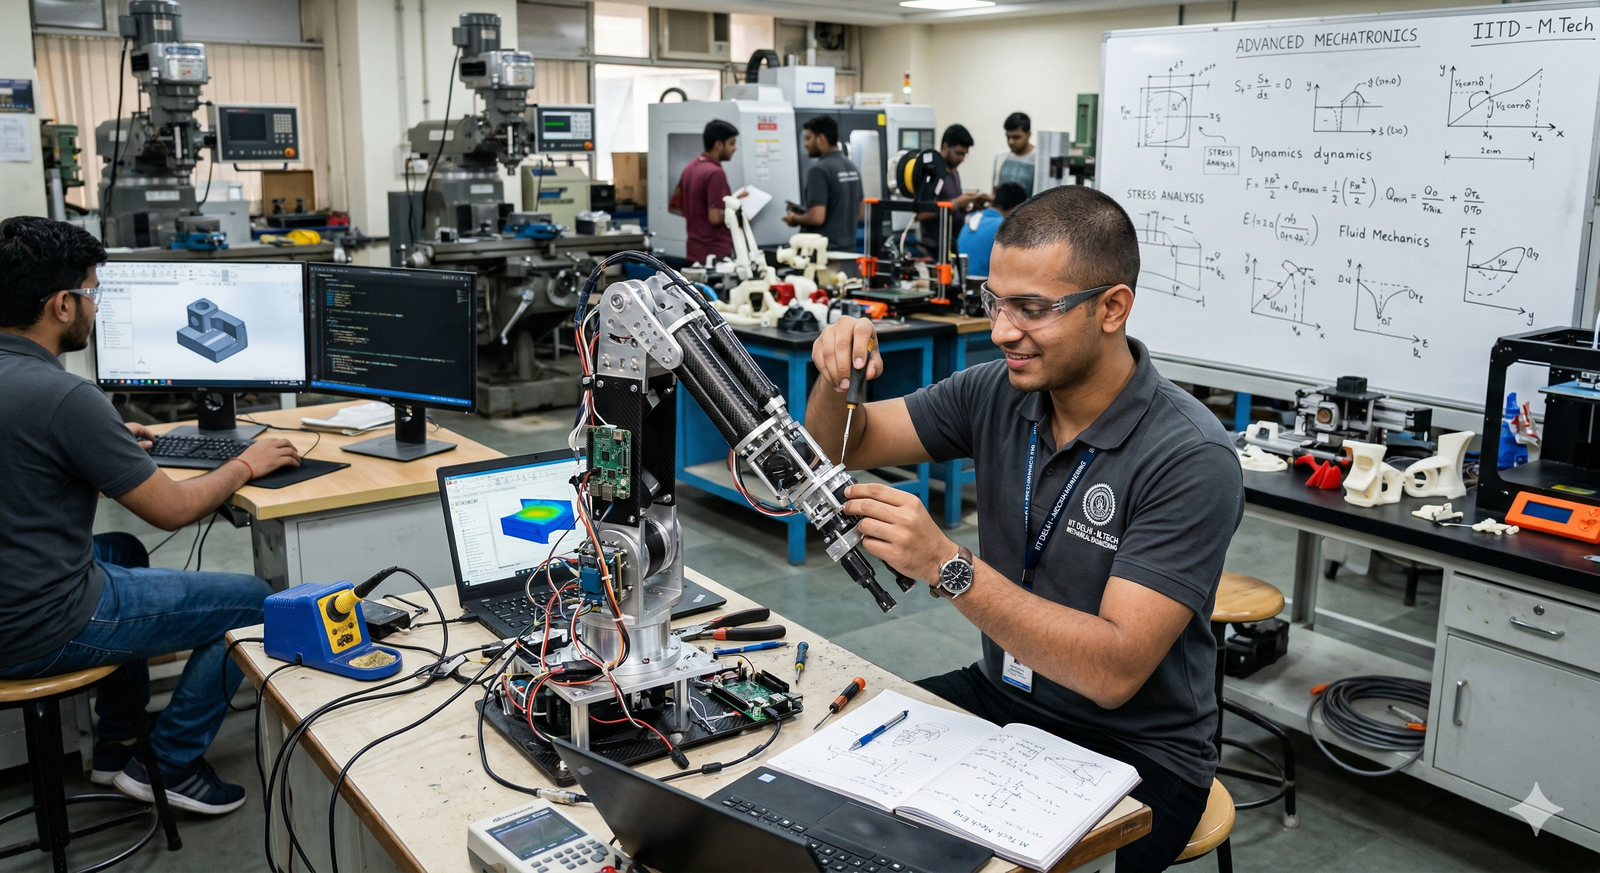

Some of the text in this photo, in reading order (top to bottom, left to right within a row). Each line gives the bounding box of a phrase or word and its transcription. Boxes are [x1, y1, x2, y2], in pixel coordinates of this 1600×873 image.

[1473, 20, 1521, 40] IITD
[1538, 16, 1594, 34] M.Tech
[1236, 27, 1418, 53] ADVANCED MECHATRONICS
[1250, 146, 1373, 165] Dynamics dynamics
[1127, 188, 1205, 204] STRESS ANALYSIS
[1339, 225, 1430, 248] Fluid Mechanics
[1076, 521, 1093, 535] DELHI
[971, 820, 994, 833] Mech
[997, 831, 1030, 848] M.Tech
